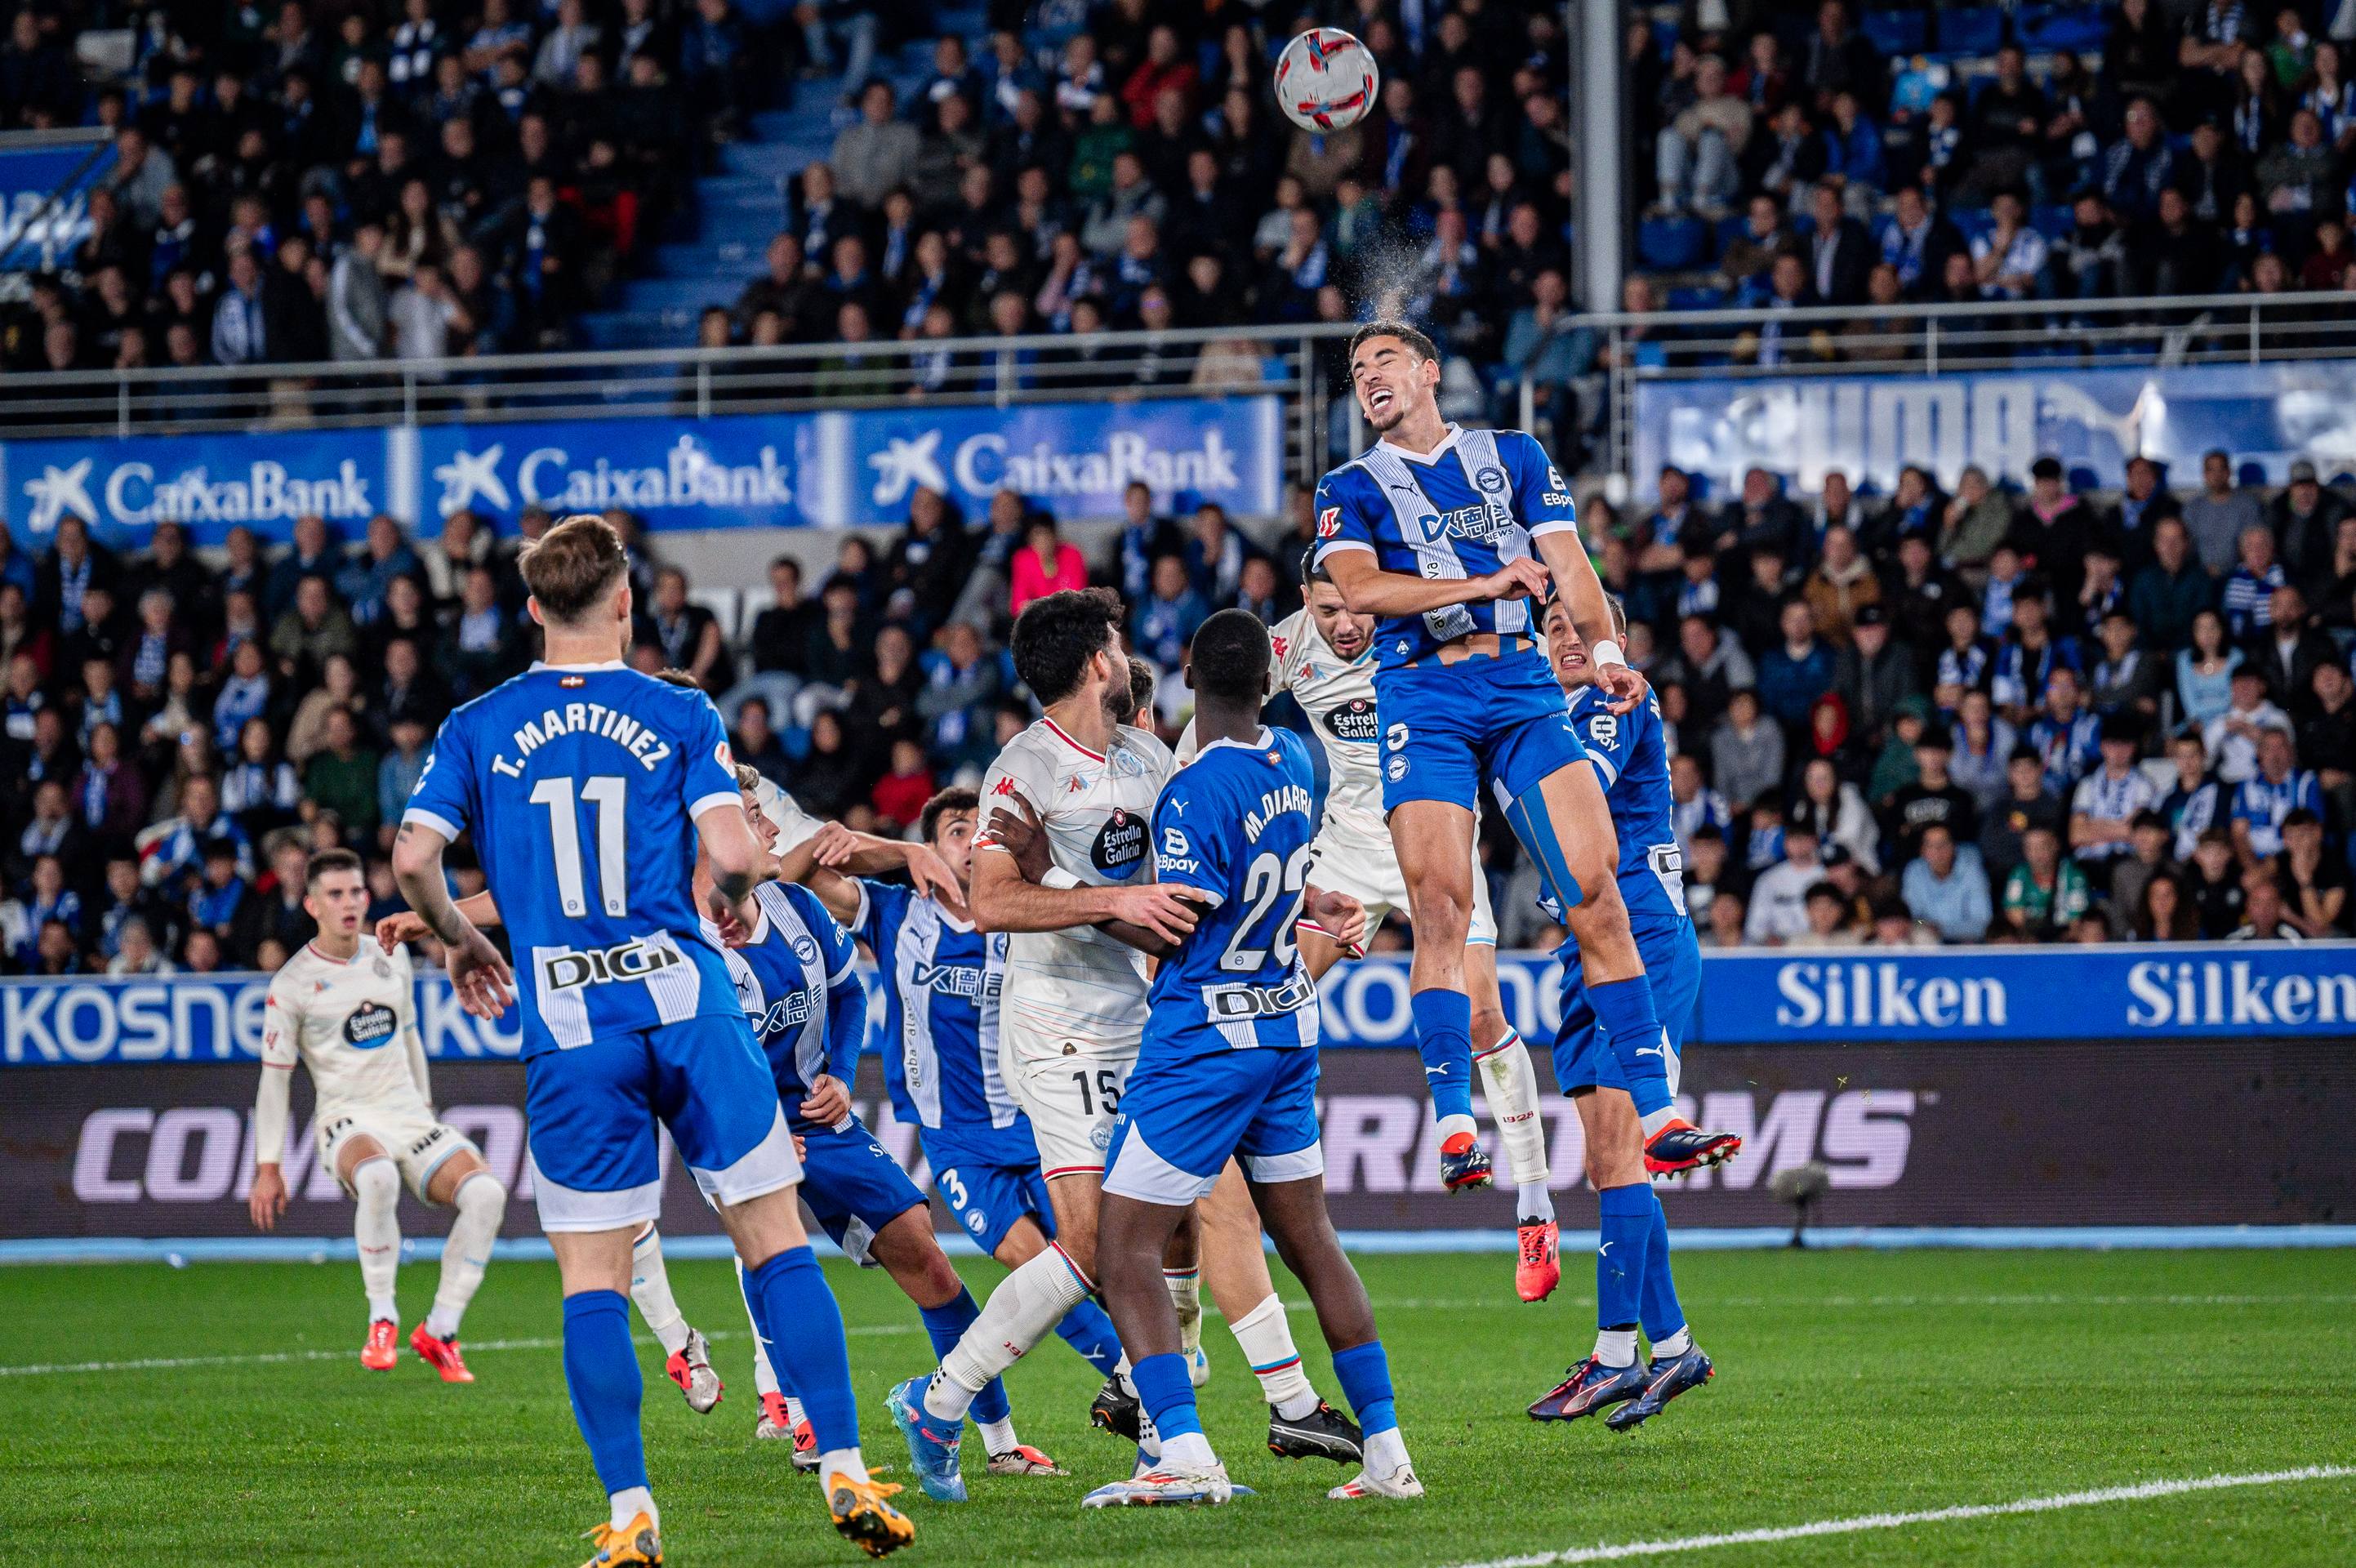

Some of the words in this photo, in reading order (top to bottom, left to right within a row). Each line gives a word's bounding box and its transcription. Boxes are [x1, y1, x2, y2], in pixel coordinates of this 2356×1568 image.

[518, 444, 792, 513] CaixaBank
[954, 430, 1239, 497] CaixaBank
[106, 458, 373, 526] CaixaBank
[1485, 528, 1514, 543] NEWS
[1334, 712, 1378, 726] Estrell
[1338, 725, 1378, 738] Galici
[529, 776, 626, 917] 11
[1103, 825, 1142, 848] Estrella
[1106, 844, 1140, 864] Galicia
[1220, 842, 1309, 970] 22
[546, 942, 680, 991] DIGI
[1776, 962, 2006, 1027] Silken
[2127, 960, 2356, 1027] Silken
[1072, 1070, 1122, 1115] 15
[1503, 1111, 1534, 1123] 1928
[942, 1169, 968, 1210] 3
